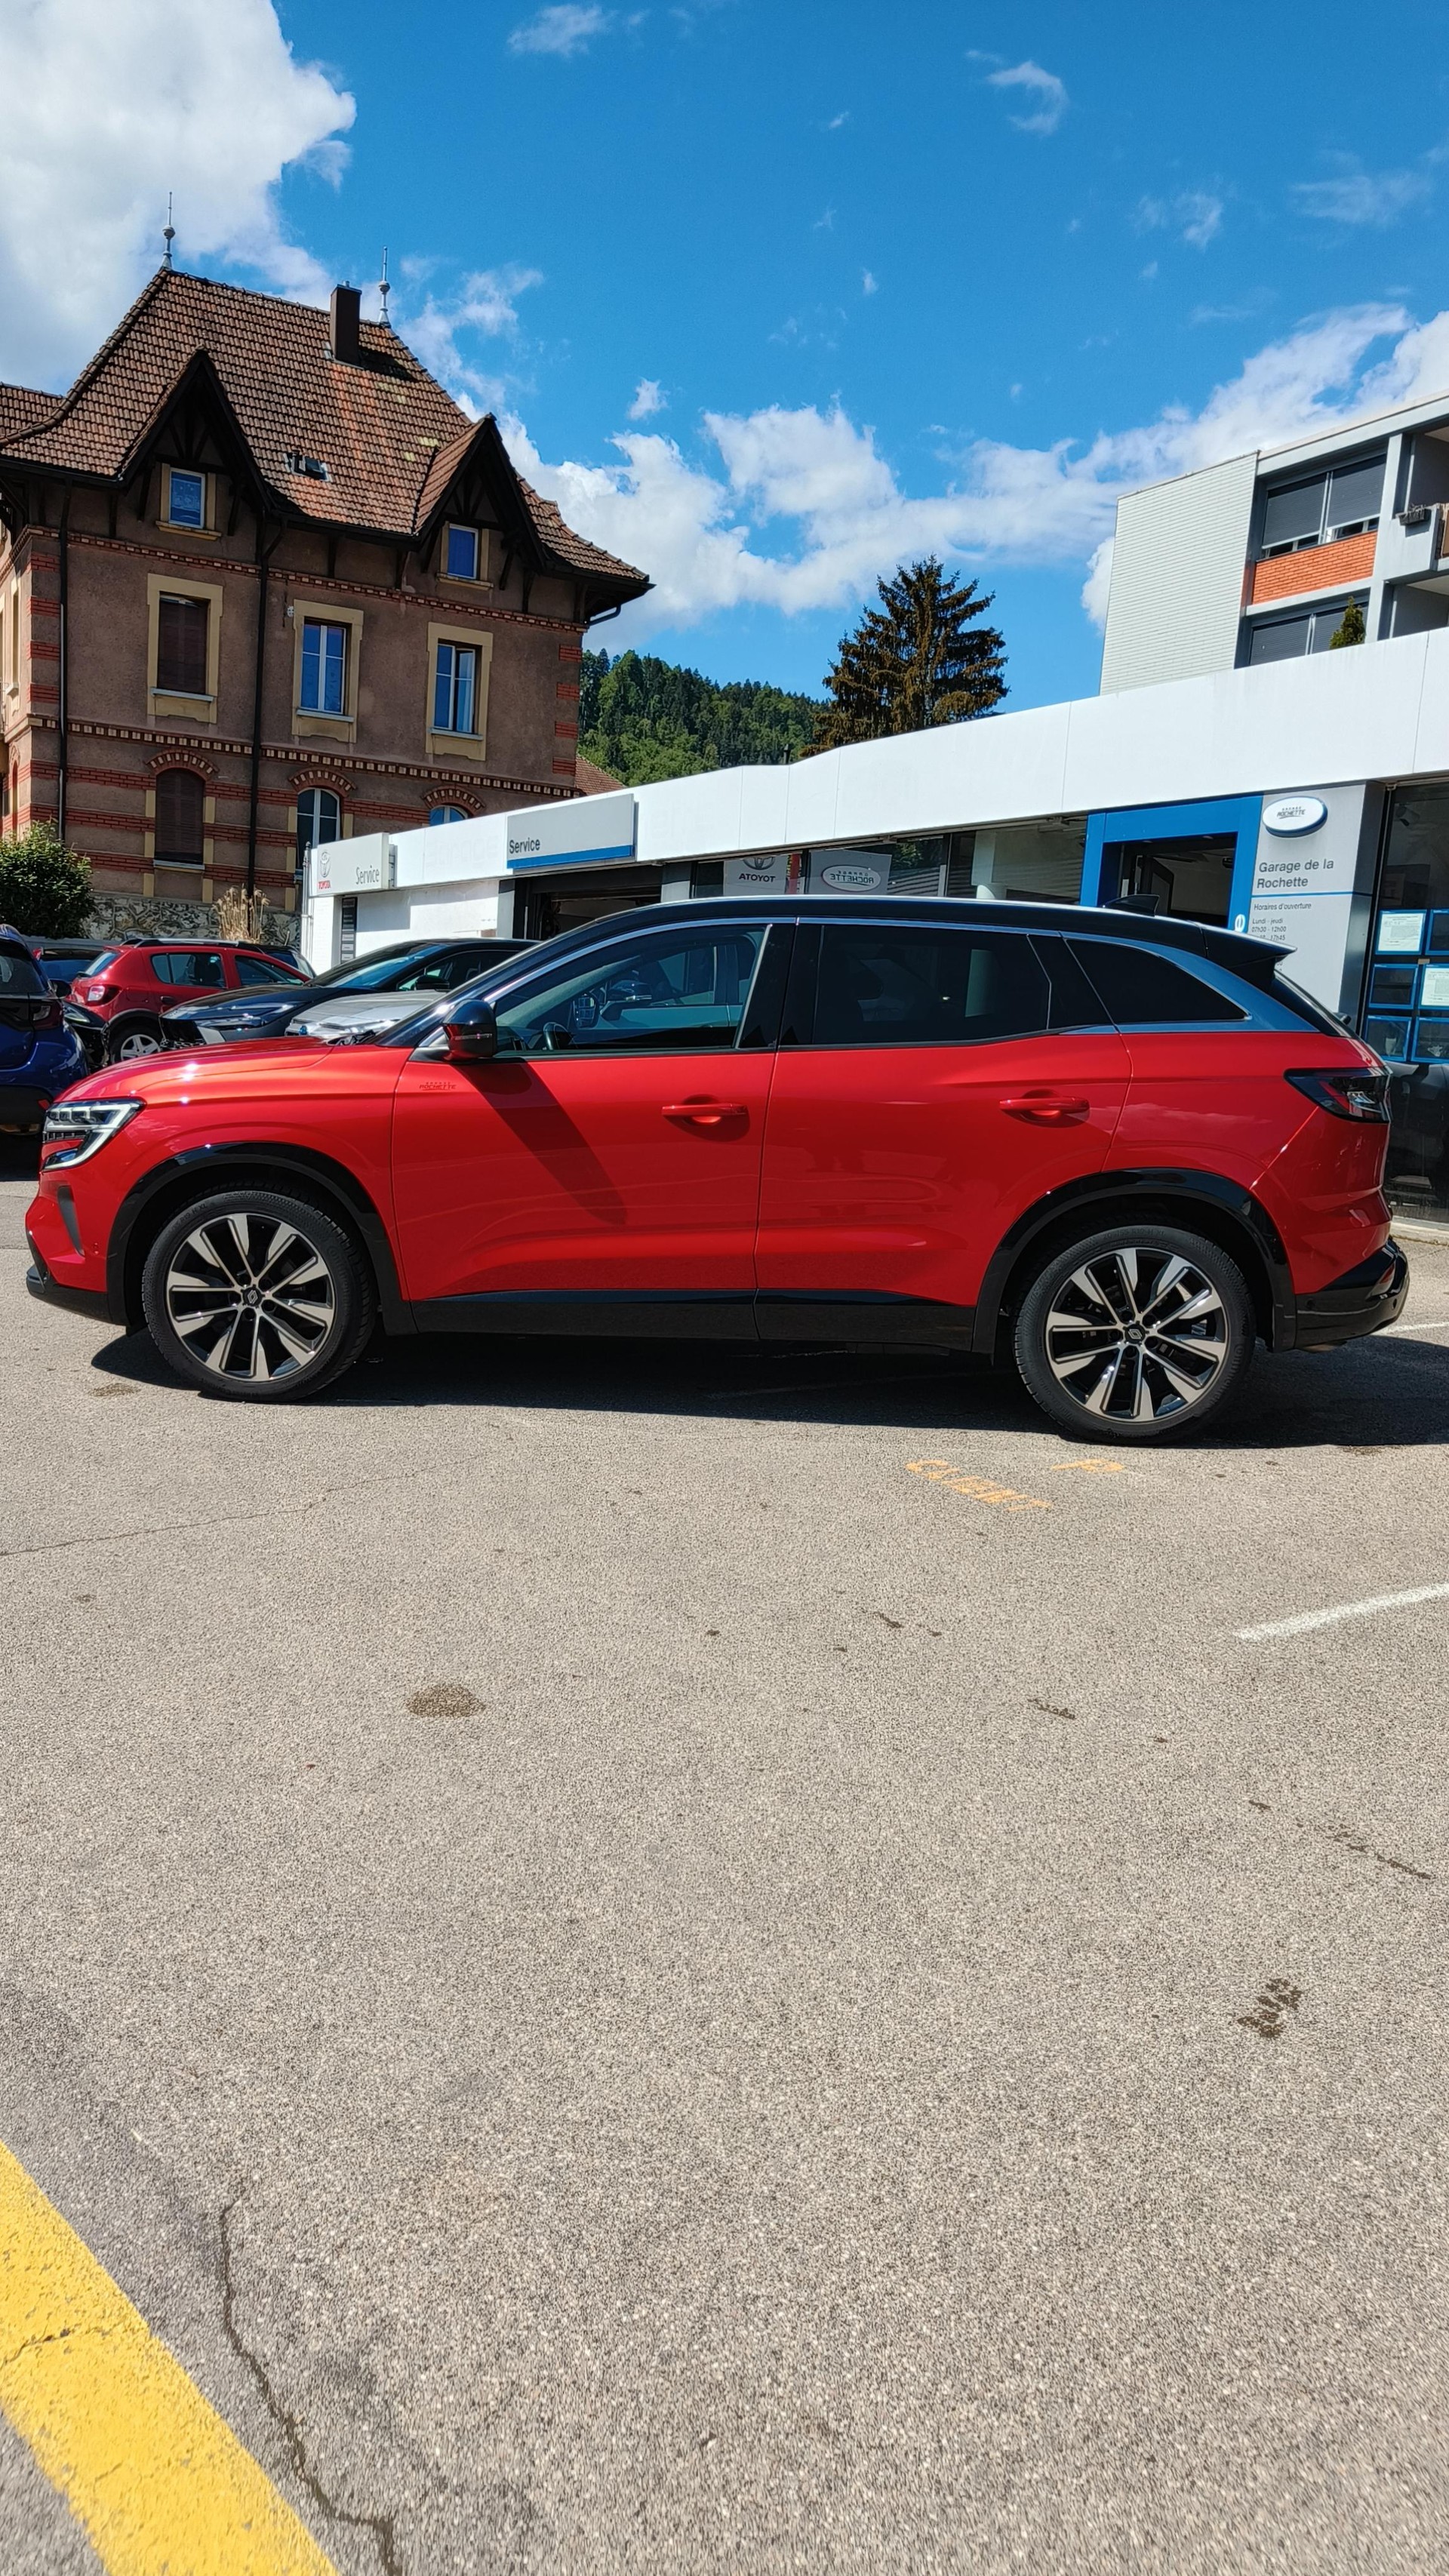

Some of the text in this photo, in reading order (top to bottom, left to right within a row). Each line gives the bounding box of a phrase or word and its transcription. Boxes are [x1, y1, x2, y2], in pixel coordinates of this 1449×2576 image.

[1277, 809, 1306, 817] ROCHETTE
[509, 837, 540, 854] Service
[1259, 858, 1334, 873] Garage de la
[355, 865, 380, 885] Service
[1257, 877, 1309, 888] Rochette
